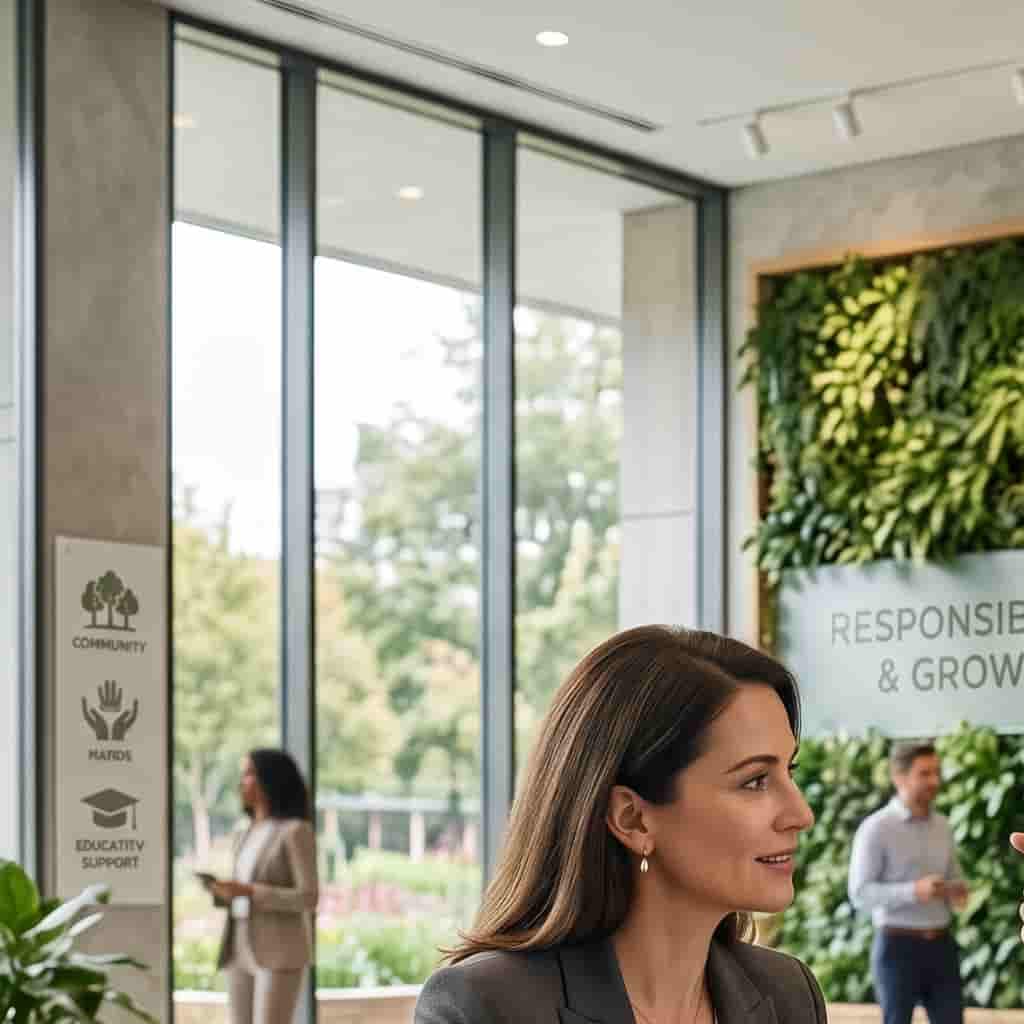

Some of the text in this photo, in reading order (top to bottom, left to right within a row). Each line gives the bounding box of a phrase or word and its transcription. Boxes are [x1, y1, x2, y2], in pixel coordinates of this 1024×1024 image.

[72, 636, 147, 653] COMMUNITY
[878, 657, 899, 693] &
[81, 855, 140, 869] SUPPORT
